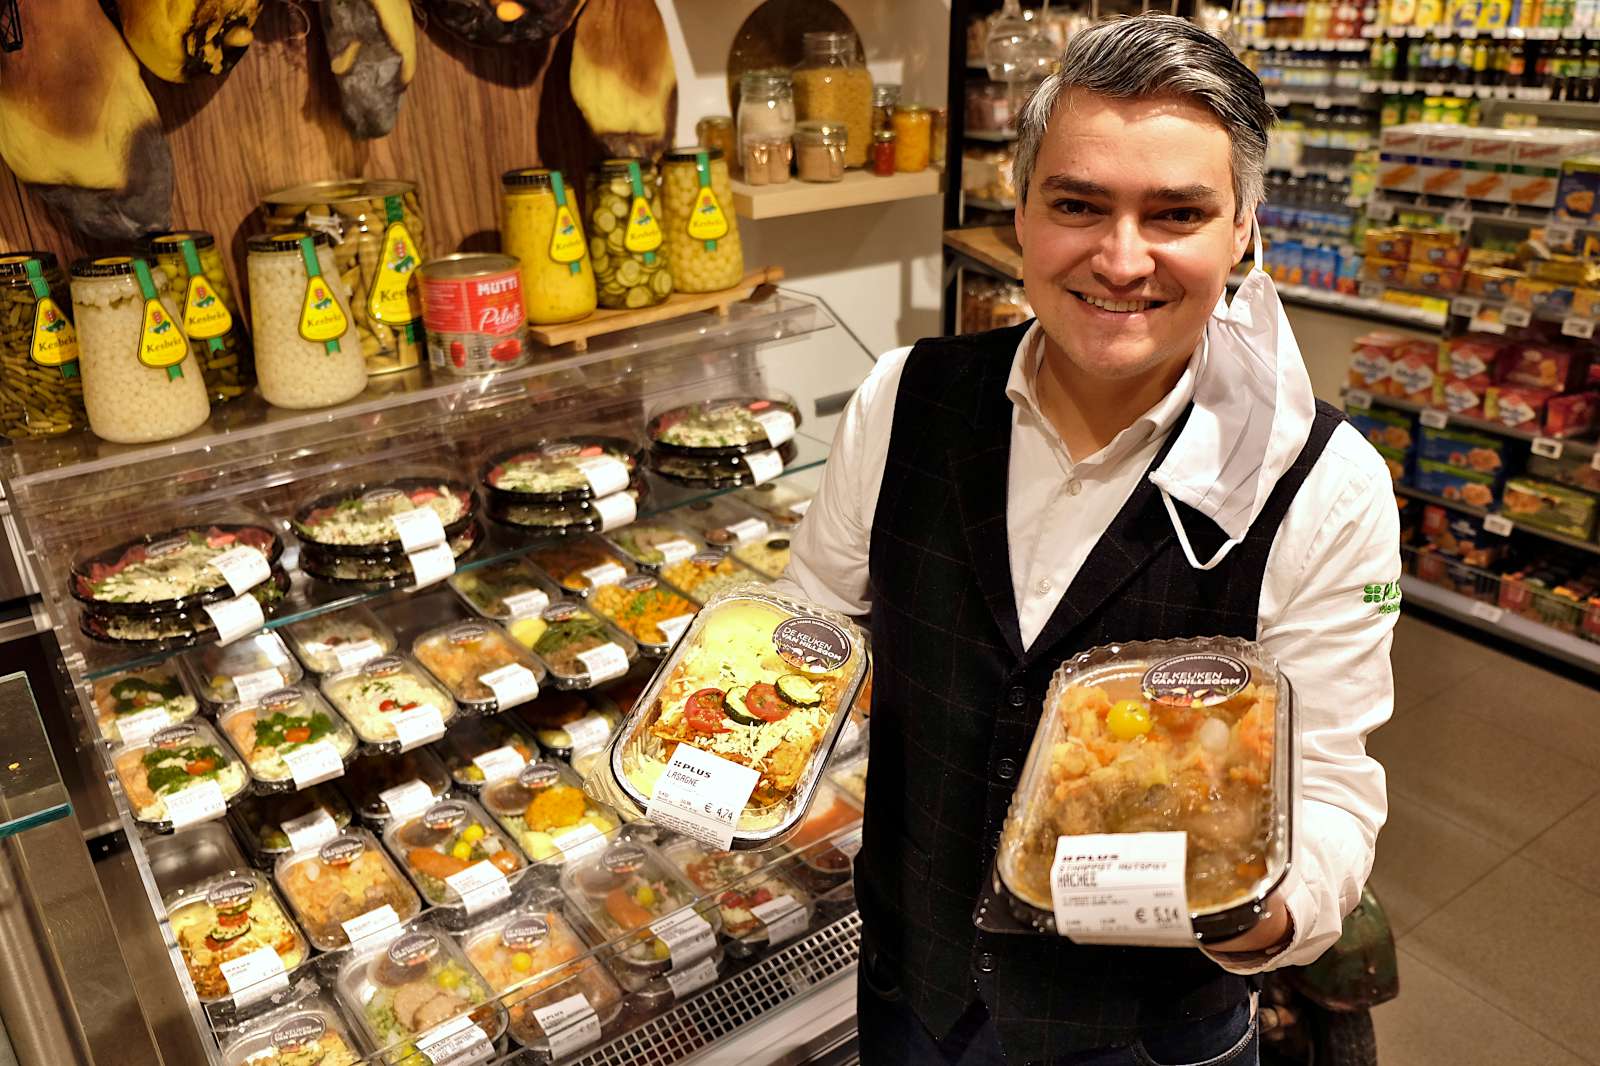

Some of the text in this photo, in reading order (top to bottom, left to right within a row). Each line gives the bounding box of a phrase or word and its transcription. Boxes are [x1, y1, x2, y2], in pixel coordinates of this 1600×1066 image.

[477, 275, 518, 297] MUTTI
[146, 335, 182, 354] Kesbeke
[782, 632, 798, 644] VAN
[799, 641, 842, 661] HILLEGOM
[783, 626, 798, 637] DE
[797, 632, 833, 651] KEUKEN
[1153, 671, 1223, 680] DE KEUKEN
[666, 769, 700, 787] LASAGNE
[682, 763, 712, 778] PLUS
[704, 802, 713, 814] €
[1057, 871, 1097, 888] HACHEE
[1135, 907, 1147, 924] €
